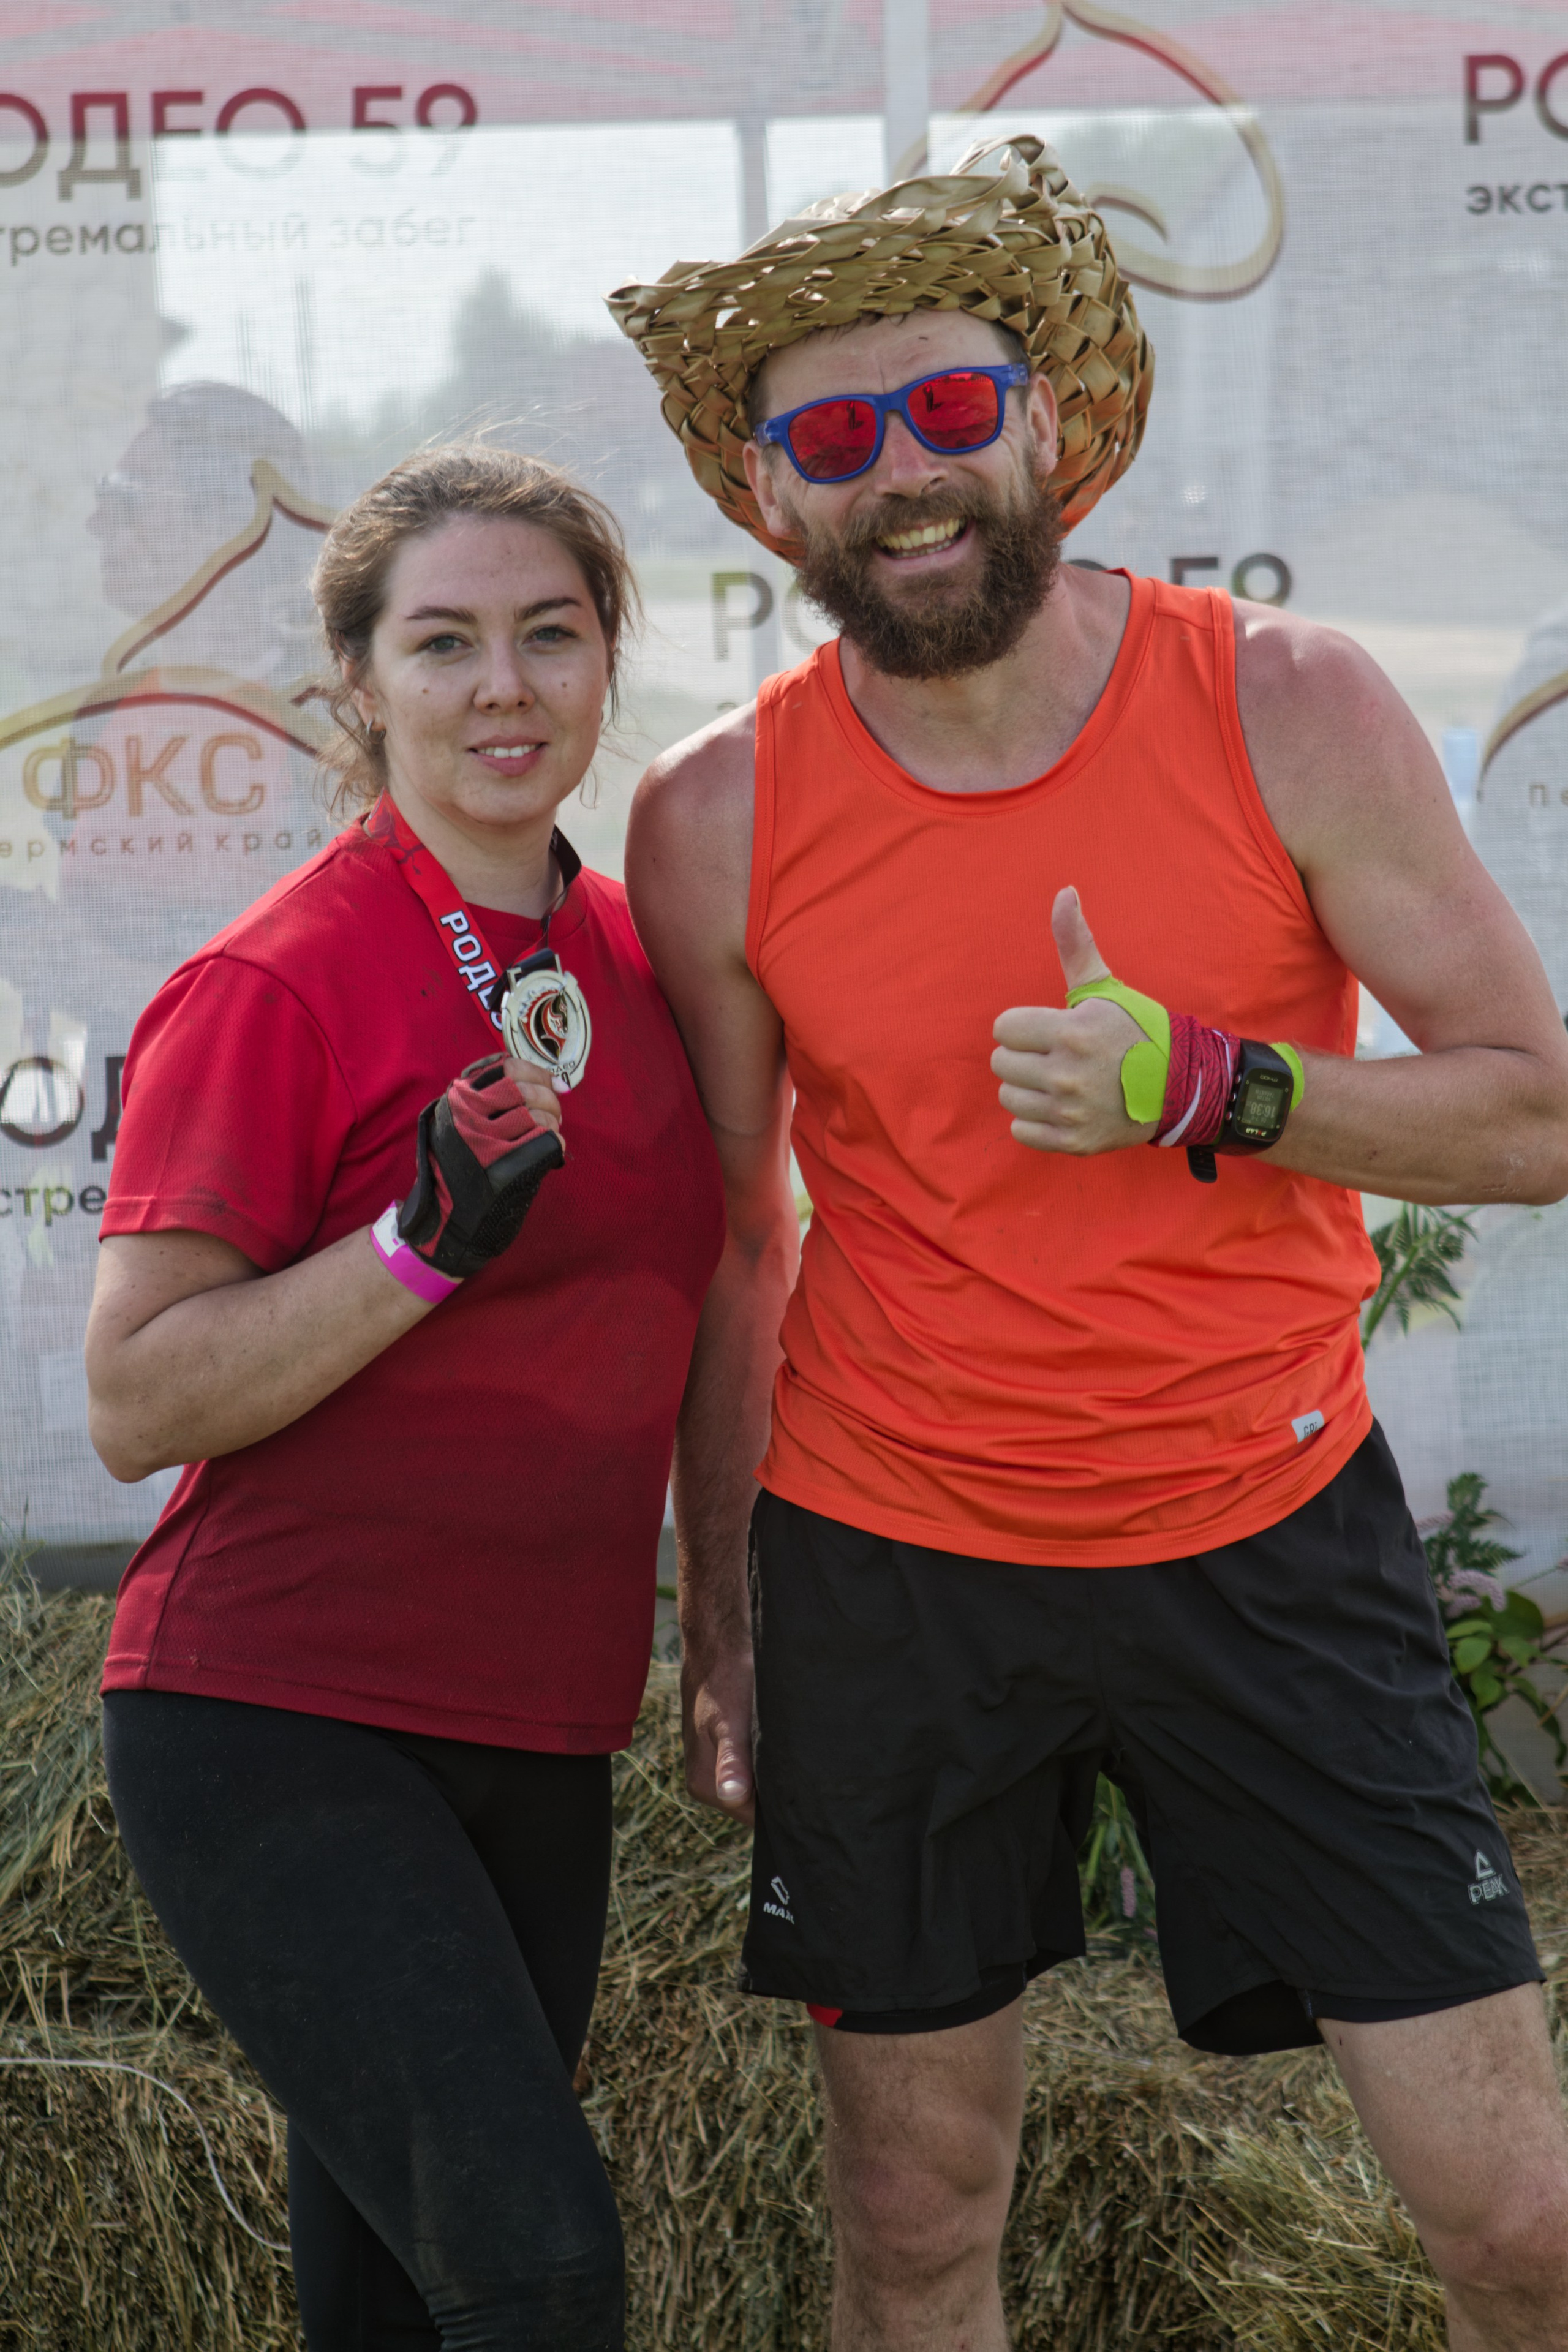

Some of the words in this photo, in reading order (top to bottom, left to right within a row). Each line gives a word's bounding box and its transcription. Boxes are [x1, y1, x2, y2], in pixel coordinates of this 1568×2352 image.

[0, 213, 307, 268] ремальный
[23, 732, 265, 819] ФКС
[216, 827, 323, 855] край
[1250, 1101, 1276, 1119] 16:38
[1245, 1127, 1267, 1137] POLAR
[1468, 1874, 1510, 1905] PEAK
